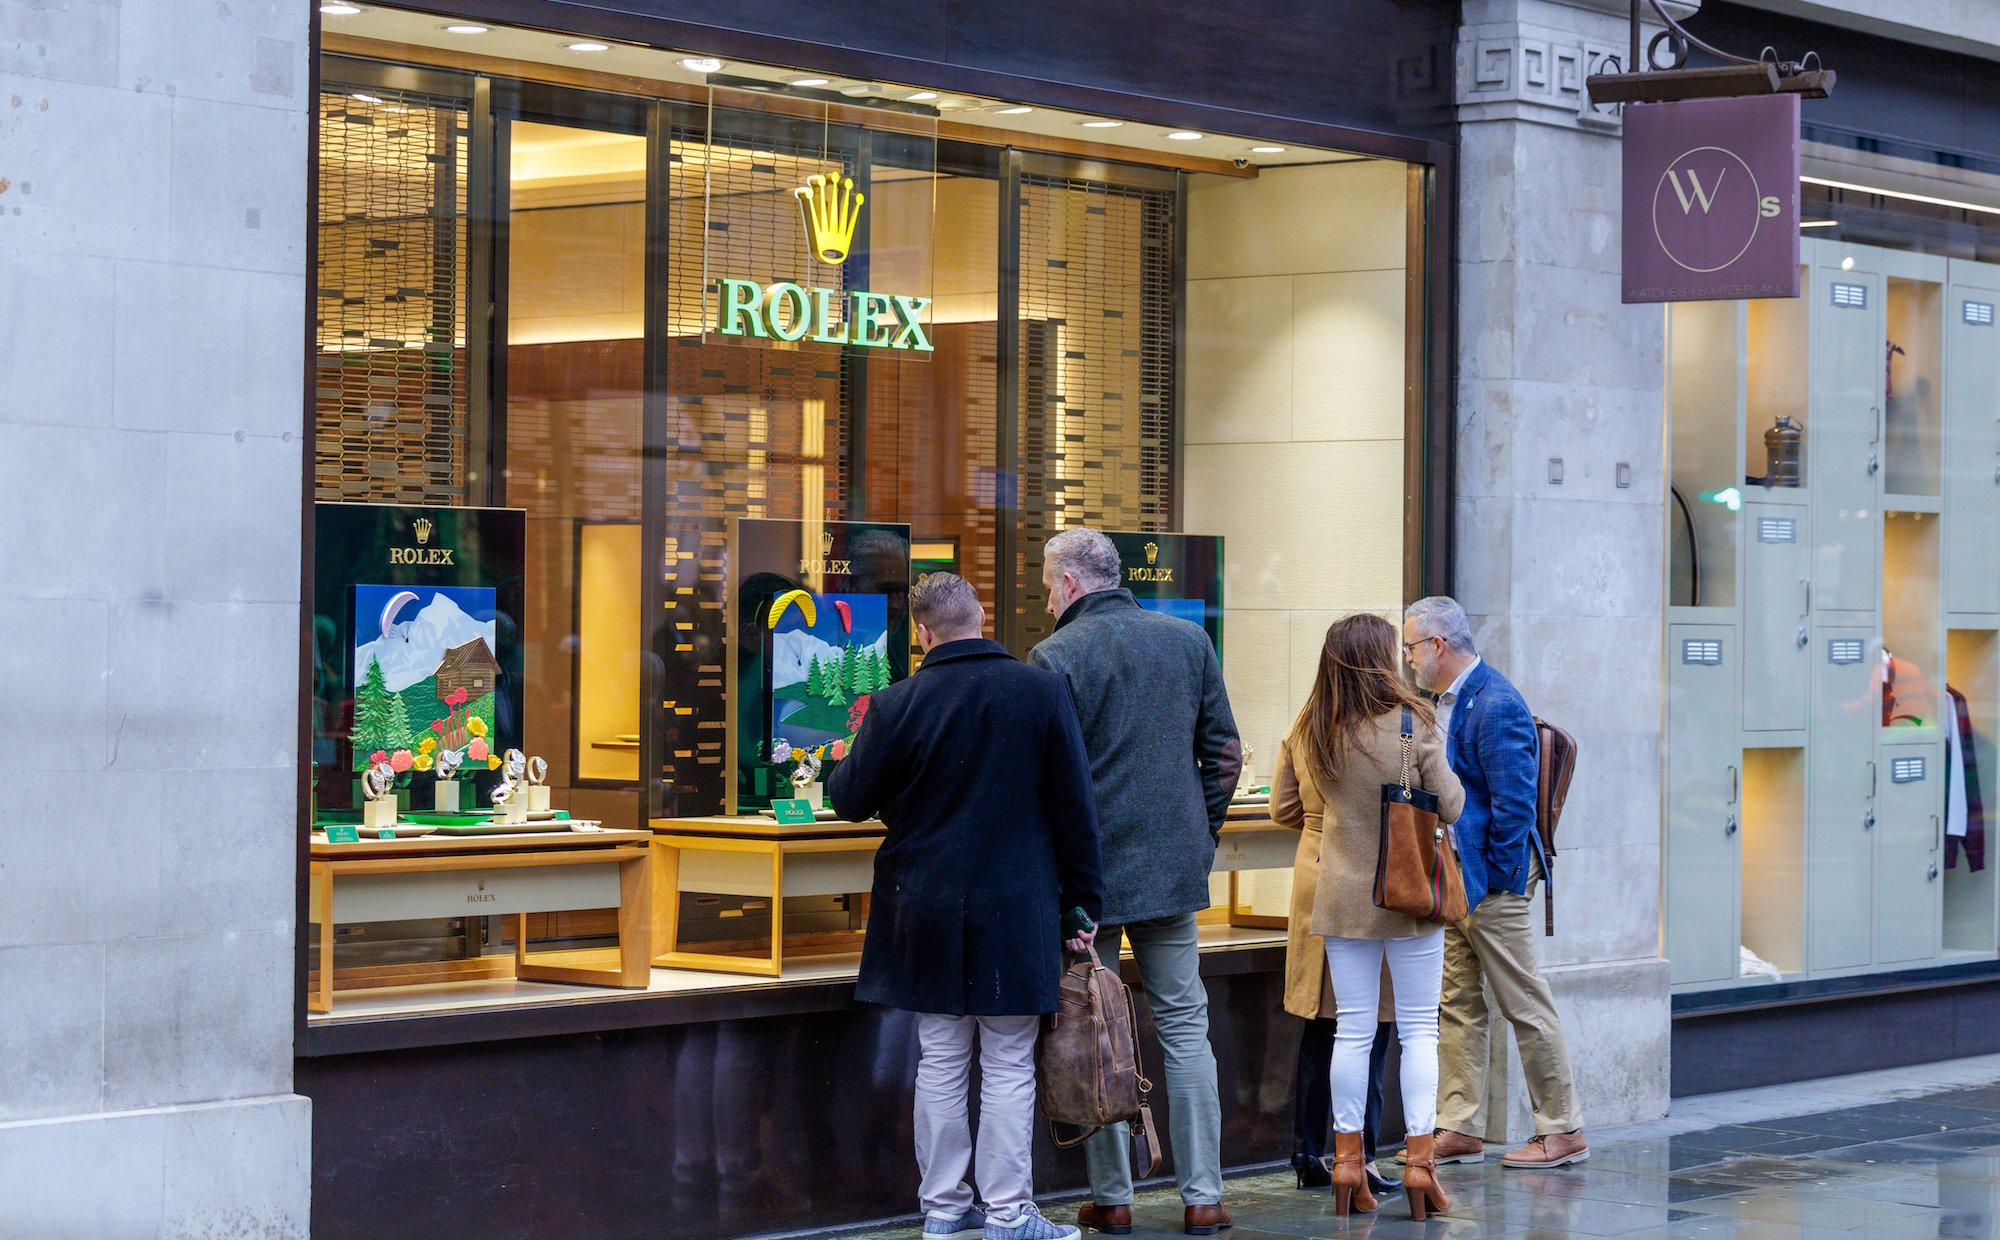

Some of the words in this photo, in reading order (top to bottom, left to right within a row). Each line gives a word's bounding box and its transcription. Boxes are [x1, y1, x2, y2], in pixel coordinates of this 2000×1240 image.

[718, 278, 935, 352] ROLEX
[389, 547, 455, 566] ROLEX
[799, 559, 852, 575] ROLEX
[1128, 567, 1174, 582] ROLEX
[467, 894, 496, 903] ROLEX
